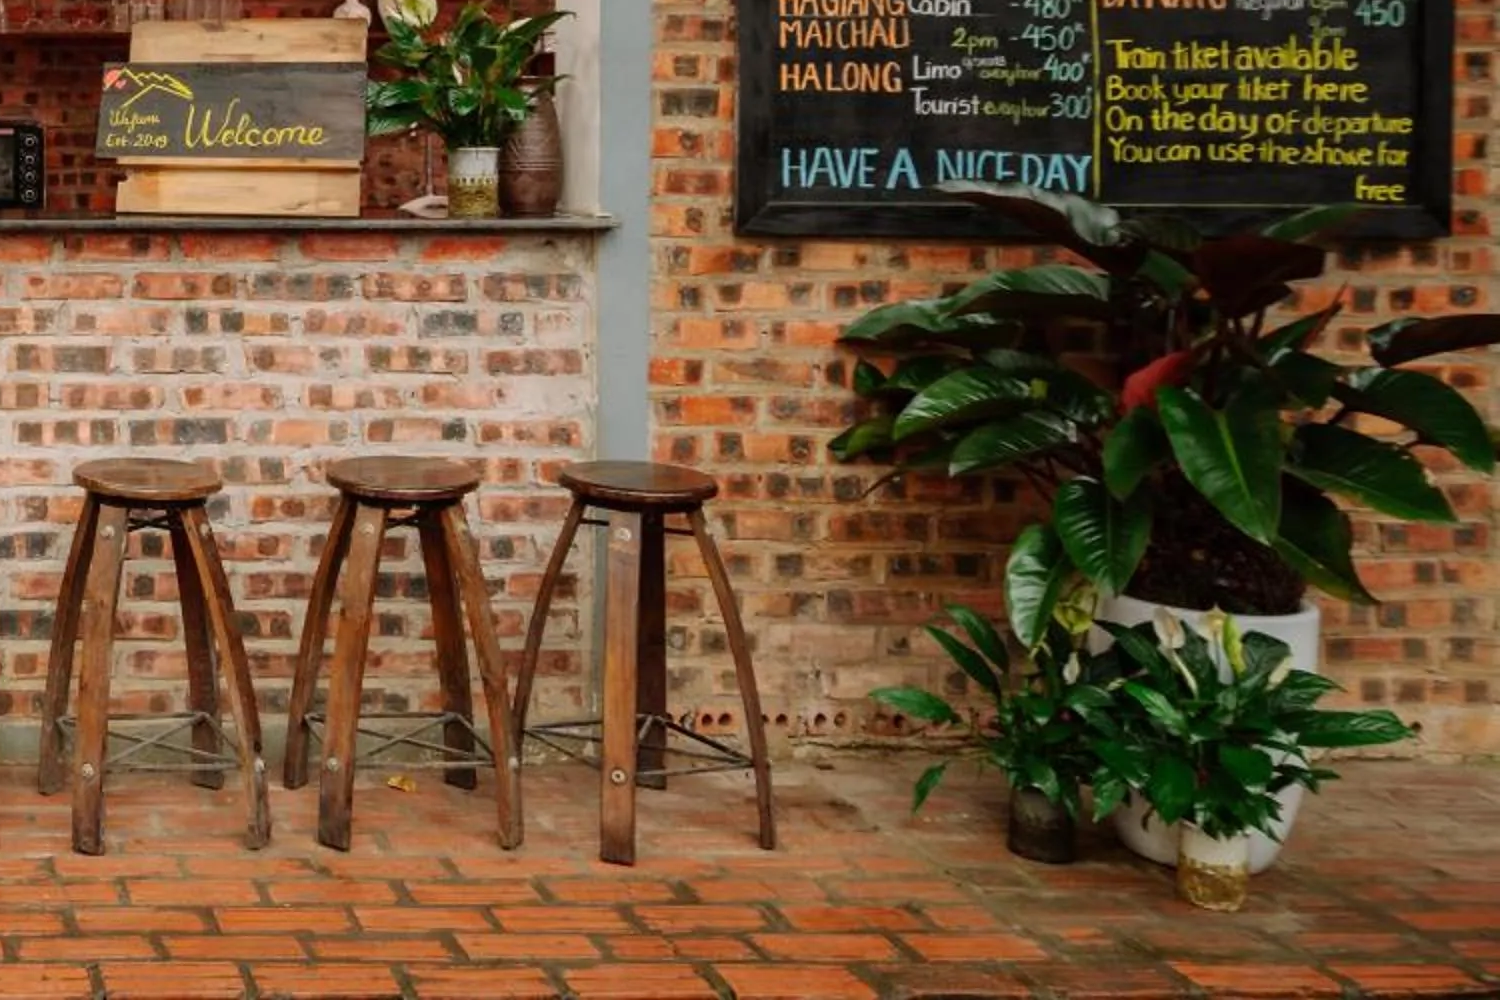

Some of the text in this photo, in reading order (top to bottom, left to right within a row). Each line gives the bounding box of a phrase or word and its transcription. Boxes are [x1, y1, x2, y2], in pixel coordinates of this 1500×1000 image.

[951, 27, 998, 55] 2pm
[1105, 39, 1167, 71] Train
[912, 54, 963, 81] Limo
[910, 87, 981, 116] Tourist
[1105, 74, 1167, 101] Book
[1172, 82, 1230, 106] your
[1303, 73, 1369, 103] here
[185, 98, 328, 150] Welcome
[1105, 105, 1144, 132] On
[1151, 100, 1196, 132] the
[1199, 103, 1260, 140] day
[1265, 109, 1301, 135] of
[1207, 142, 1256, 163] use
[1376, 140, 1410, 167] for
[781, 147, 1093, 193] HAVE A NICE DAY
[1355, 174, 1406, 201] free
